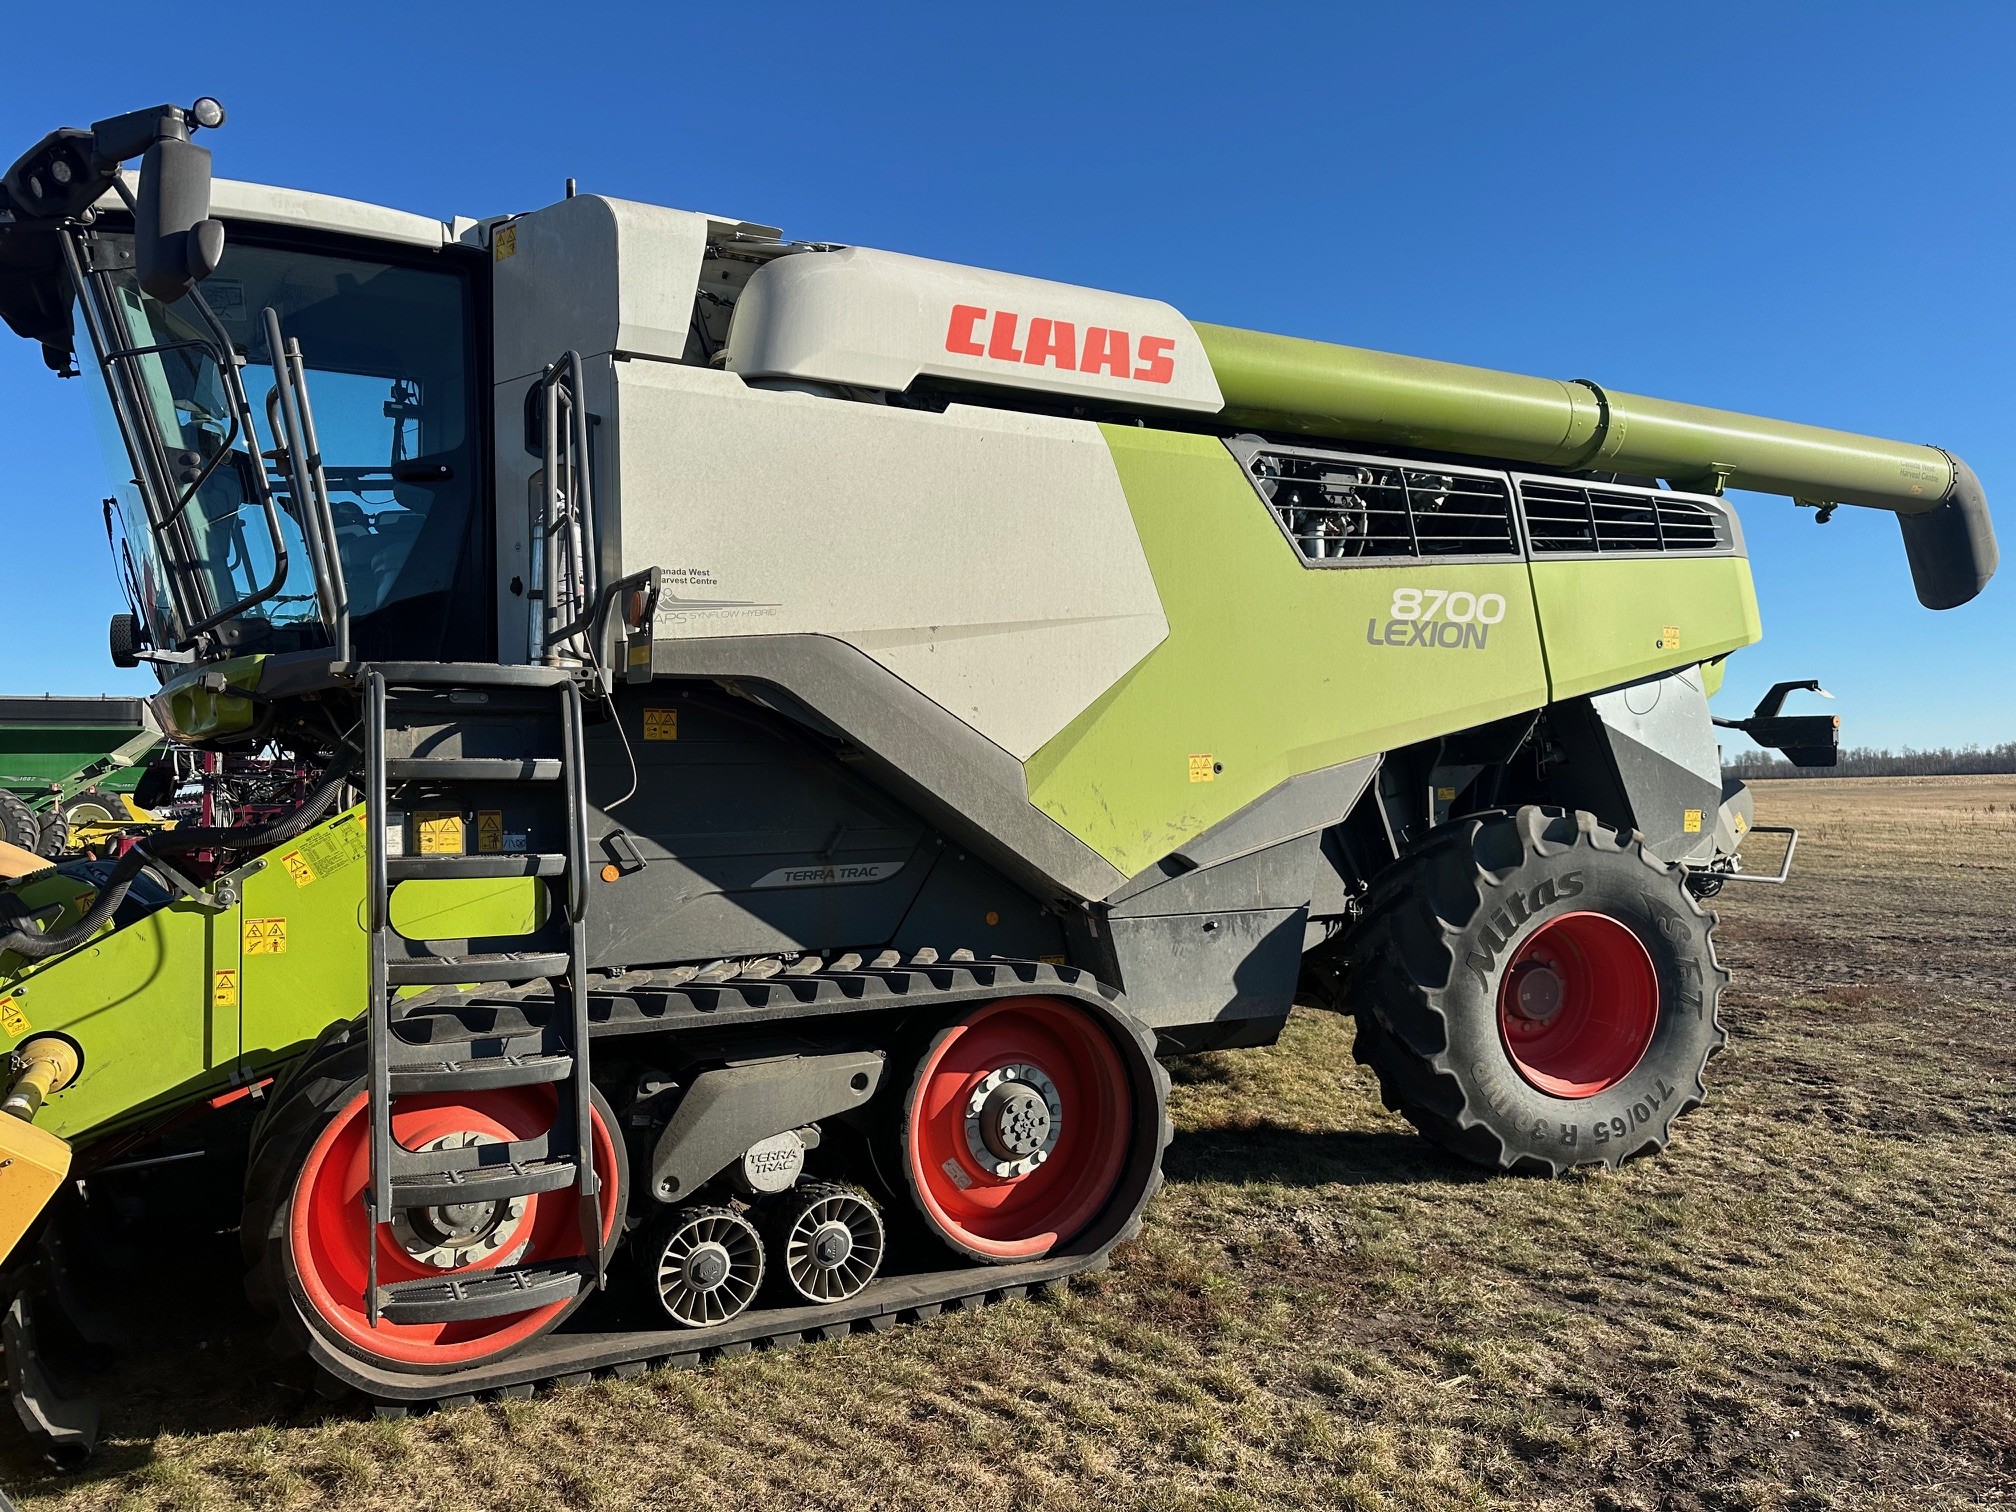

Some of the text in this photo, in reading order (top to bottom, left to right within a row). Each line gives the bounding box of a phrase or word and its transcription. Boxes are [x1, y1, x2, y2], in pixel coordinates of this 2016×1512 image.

[945, 304, 1175, 384] CLAAS
[1900, 469, 1938, 482] Harvest Centre
[661, 577, 688, 585] arvest
[654, 609, 777, 624] APS SYNFLOW HYBRID
[1390, 588, 1506, 624] 8700
[1366, 618, 1489, 649] LEXION
[784, 866, 879, 882] TERRA TRAC
[1466, 870, 1584, 994] Mitas
[1657, 916, 1704, 1021] SFT
[1513, 1109, 1549, 1141] 30
[1592, 1077, 1676, 1145] 710/65
[1559, 1122, 1578, 1147] R
[749, 1149, 797, 1174] TERRA TRAC
